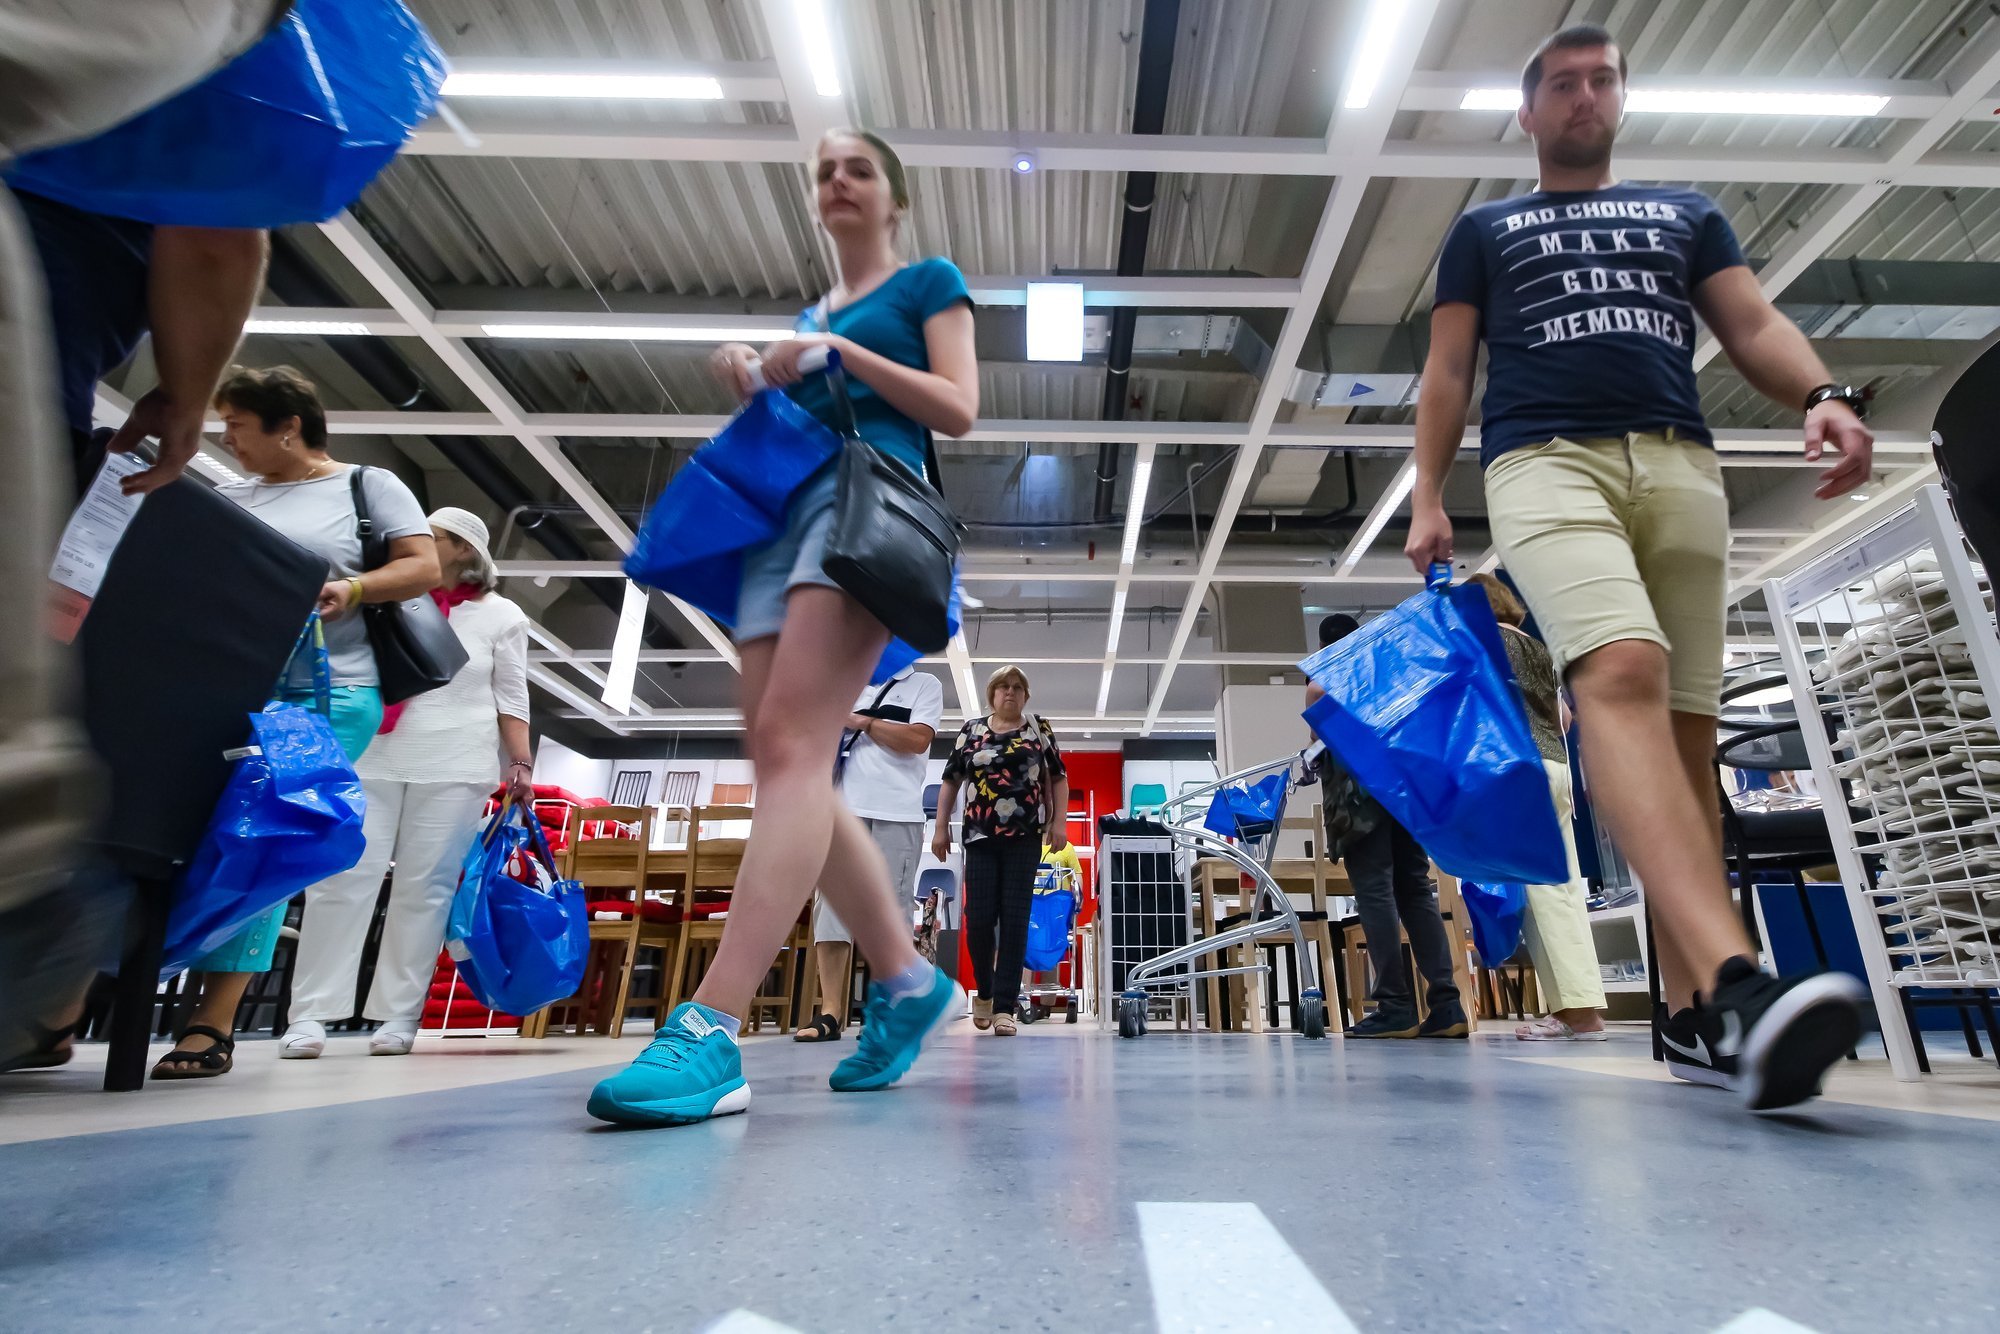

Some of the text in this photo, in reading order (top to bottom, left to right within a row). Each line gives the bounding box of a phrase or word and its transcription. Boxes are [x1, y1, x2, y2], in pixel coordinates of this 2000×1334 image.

[1506, 201, 1677, 232] BAD CHOICES
[1539, 228, 1665, 255] MAKE
[1562, 267, 1659, 294] GOOD
[1542, 308, 1684, 346] MEMORIES
